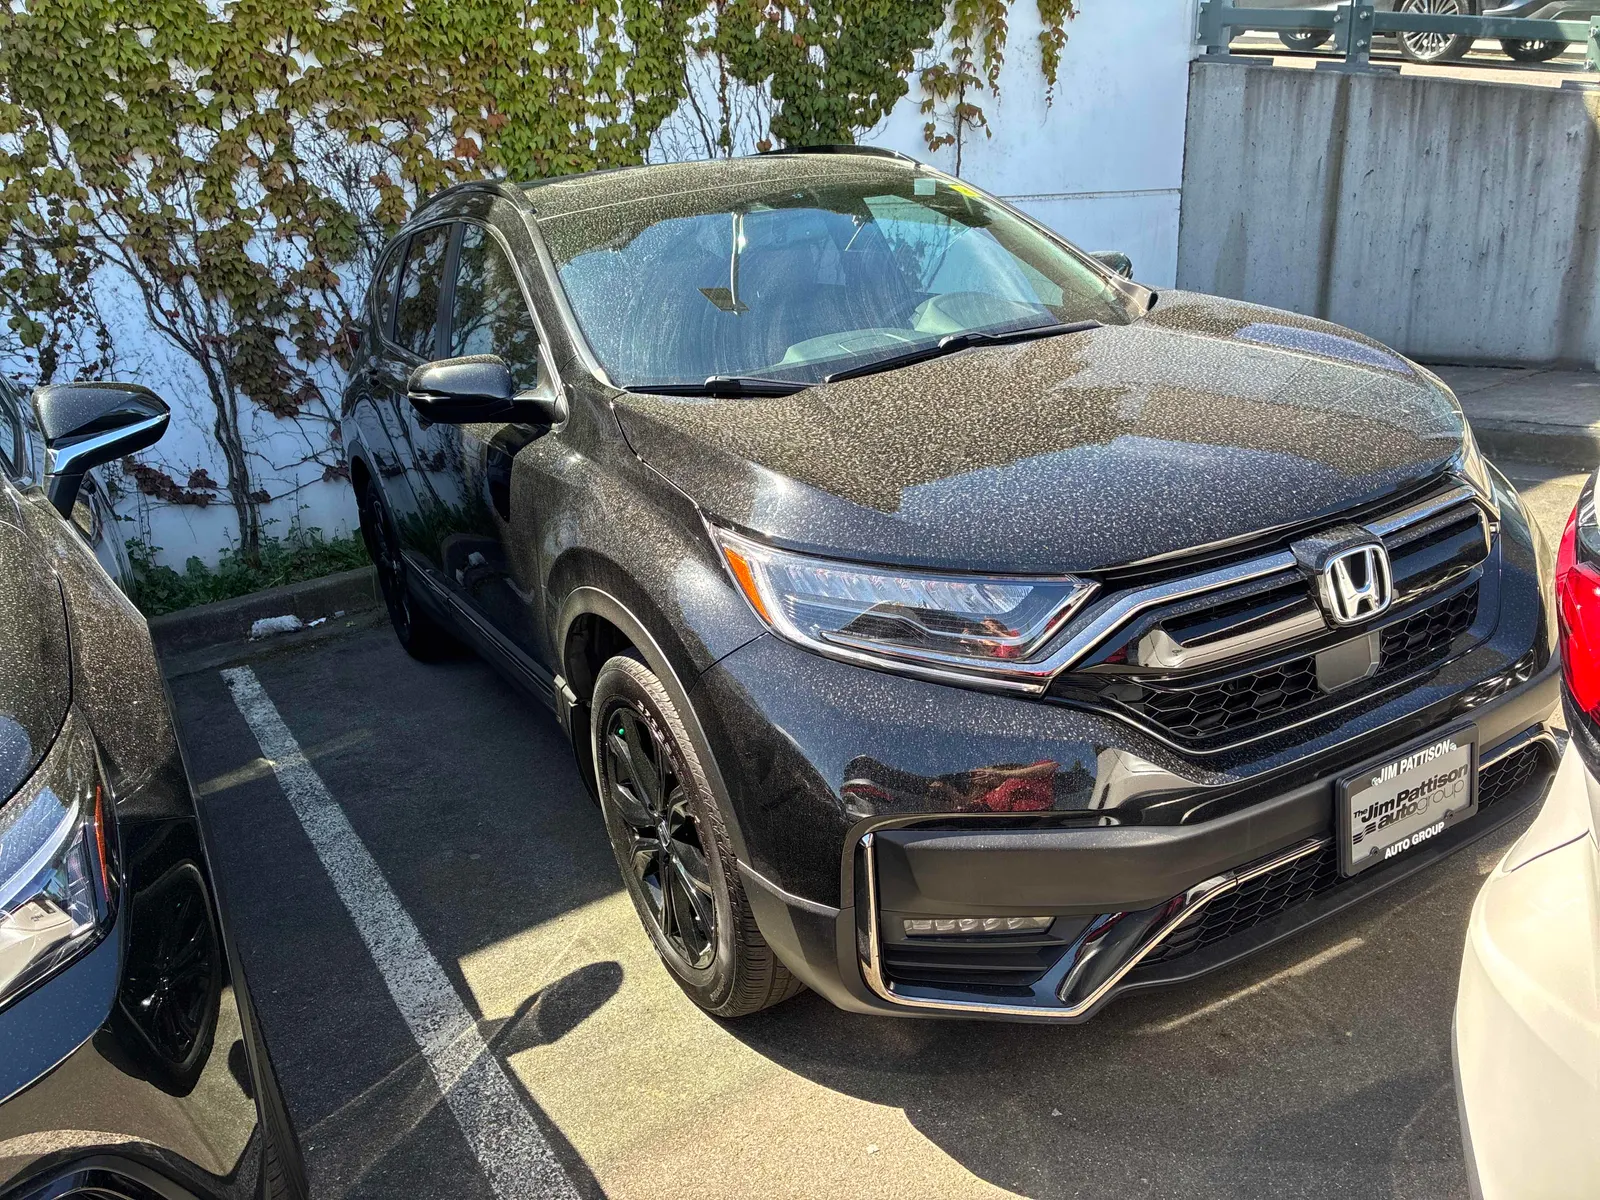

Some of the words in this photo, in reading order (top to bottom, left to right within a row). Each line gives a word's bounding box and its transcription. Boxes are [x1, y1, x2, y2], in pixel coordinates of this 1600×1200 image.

[1379, 763, 1398, 784] JIM
[1400, 739, 1451, 775] PATTISON
[1353, 808, 1368, 819] The
[1396, 763, 1469, 808] Pattison
[1384, 838, 1410, 860] AUTO
[1411, 821, 1445, 846] GROUP
